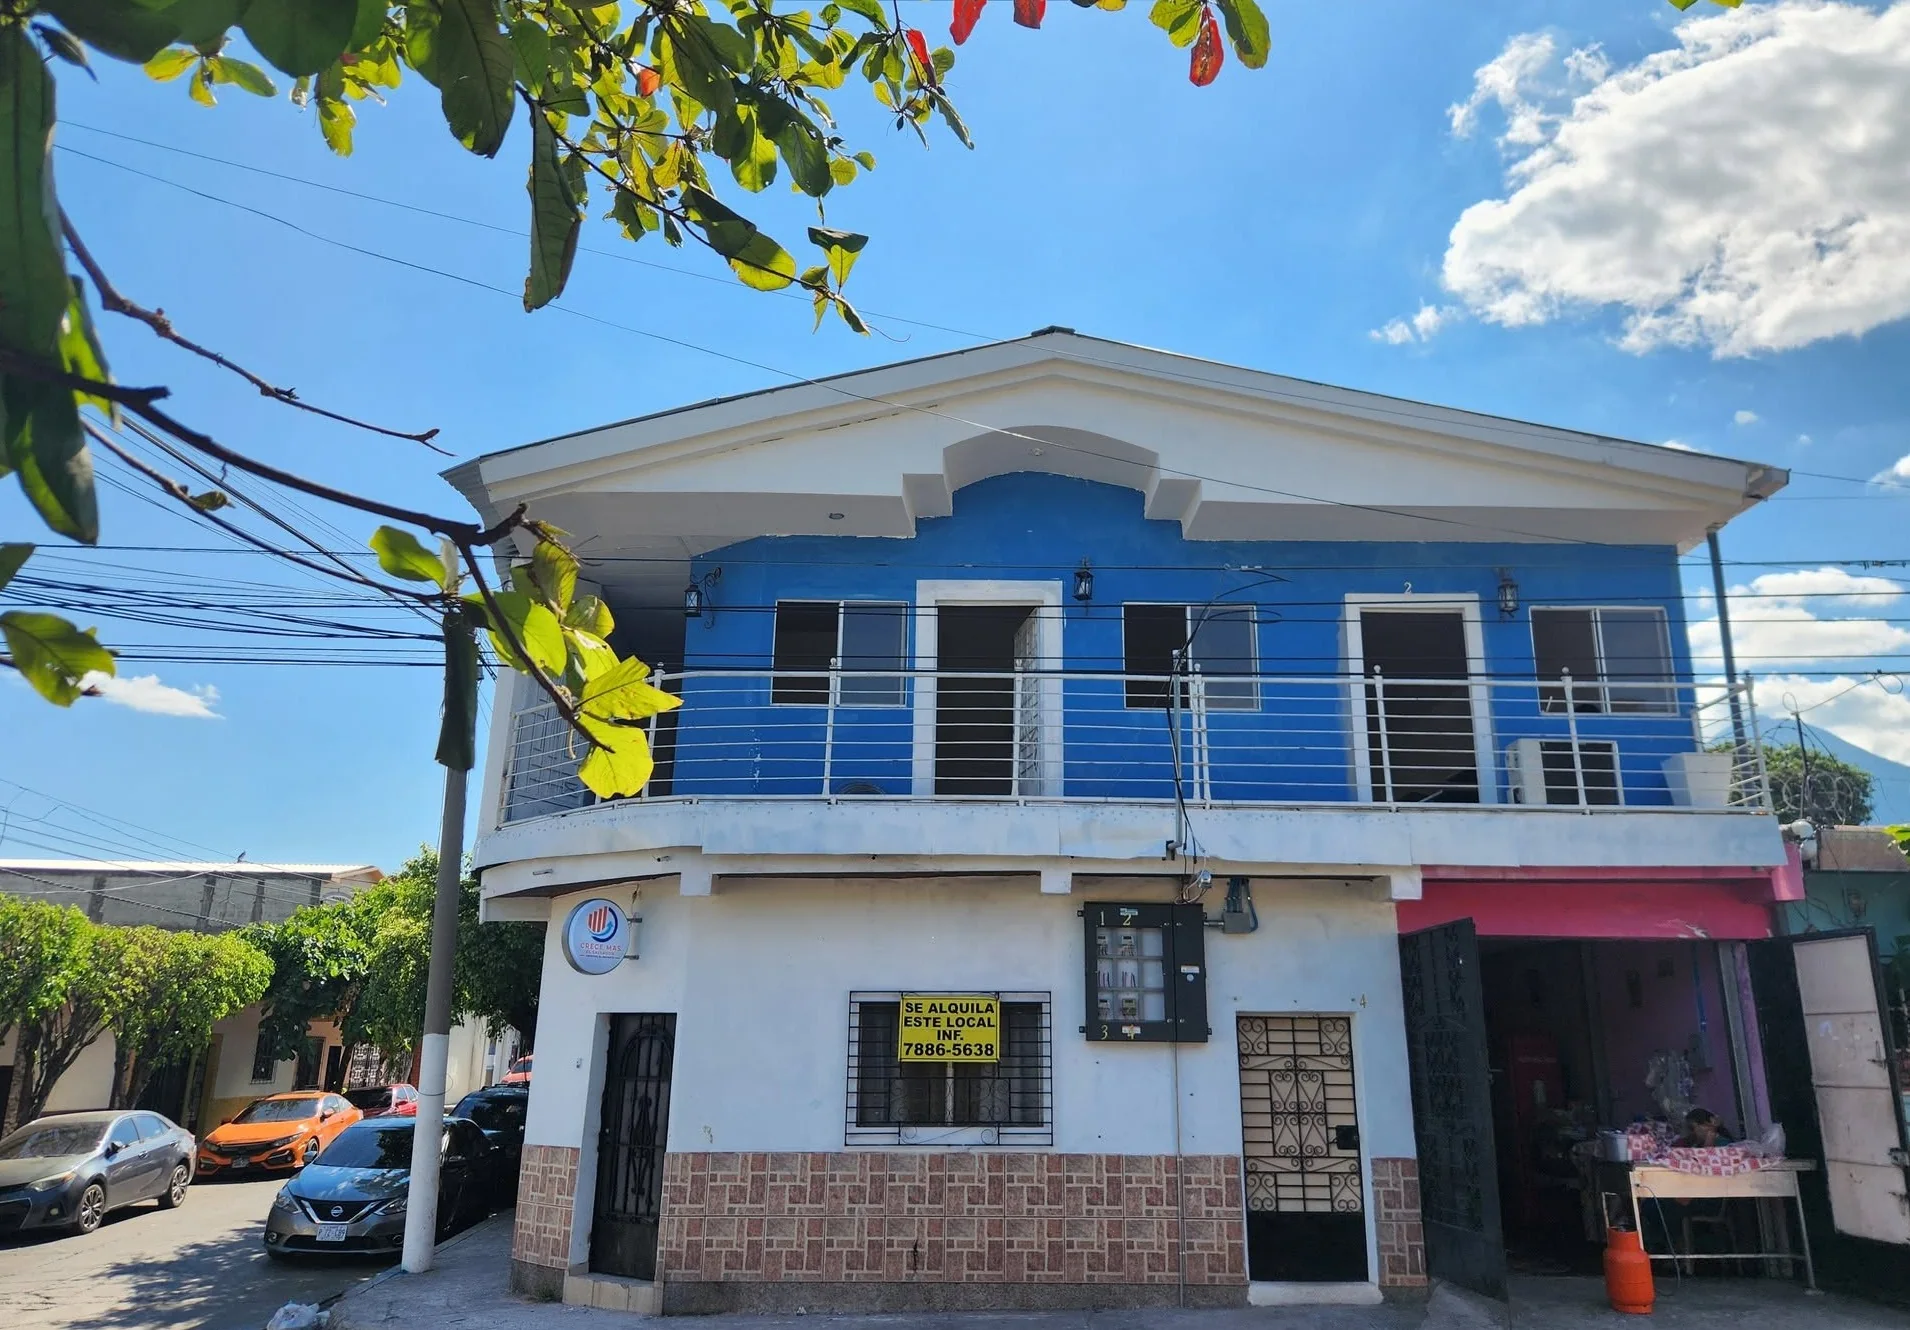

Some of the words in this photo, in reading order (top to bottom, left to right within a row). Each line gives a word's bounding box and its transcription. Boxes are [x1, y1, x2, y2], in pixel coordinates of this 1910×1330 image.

[1403, 581, 1412, 594] 2
[1100, 911, 1106, 926] 1
[1122, 913, 1132, 926] 2
[580, 942, 604, 951] CRECE
[905, 1003, 923, 1014] SE
[928, 1003, 995, 1014] ALQUILA
[903, 1017, 941, 1028] ESTE
[946, 1017, 995, 1028] LOCAL
[937, 1030, 964, 1041] INF.
[1101, 1024, 1109, 1040] 3
[903, 1043, 995, 1057] 7886-5638
